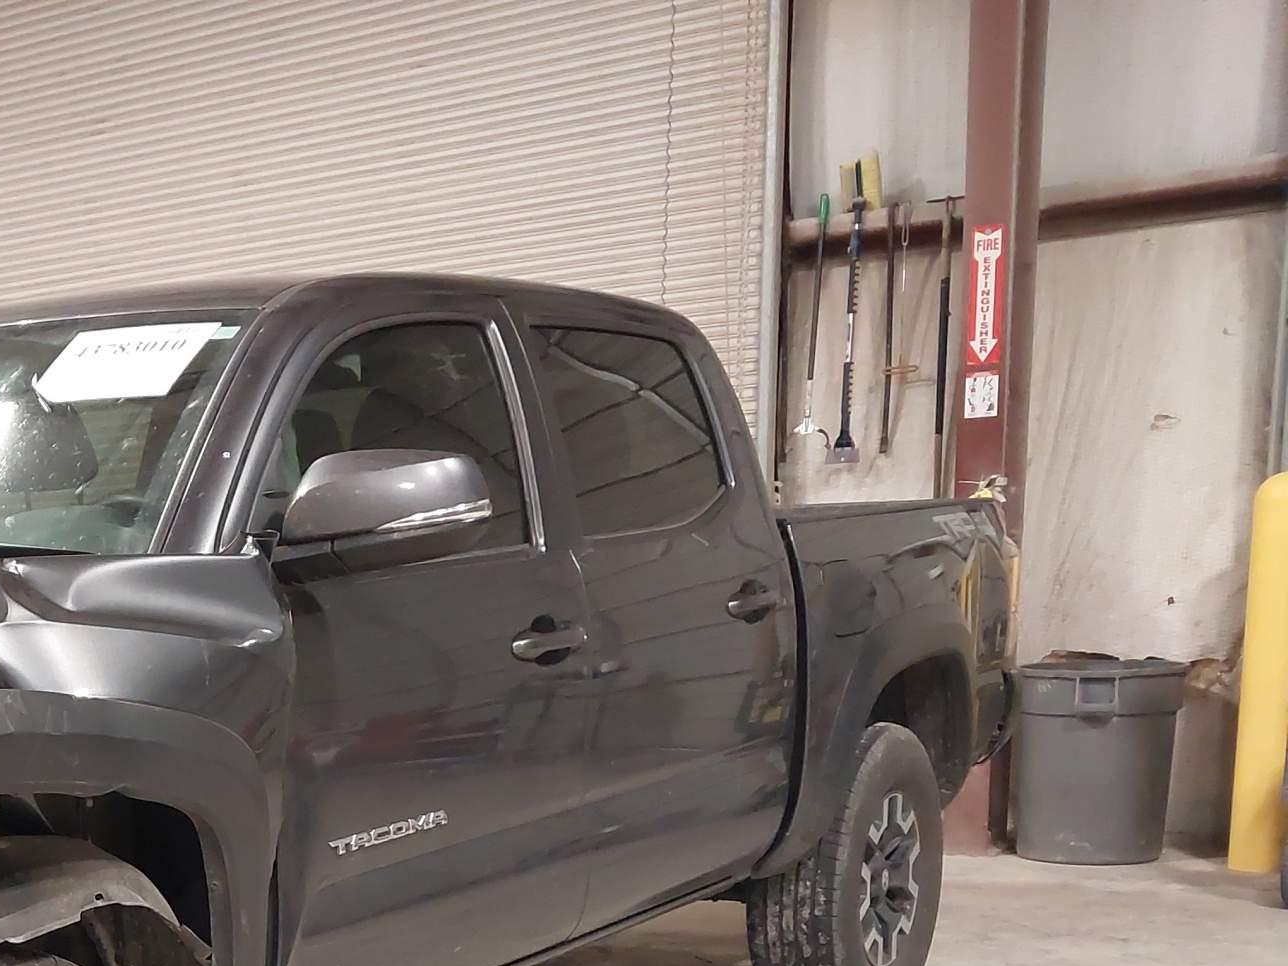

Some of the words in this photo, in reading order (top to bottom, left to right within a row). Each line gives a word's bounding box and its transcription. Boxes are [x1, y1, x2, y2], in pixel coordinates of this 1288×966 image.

[976, 238, 1000, 252] FIRE
[979, 256, 991, 354] EXTINGUISHER
[327, 809, 450, 855] TACOMA
